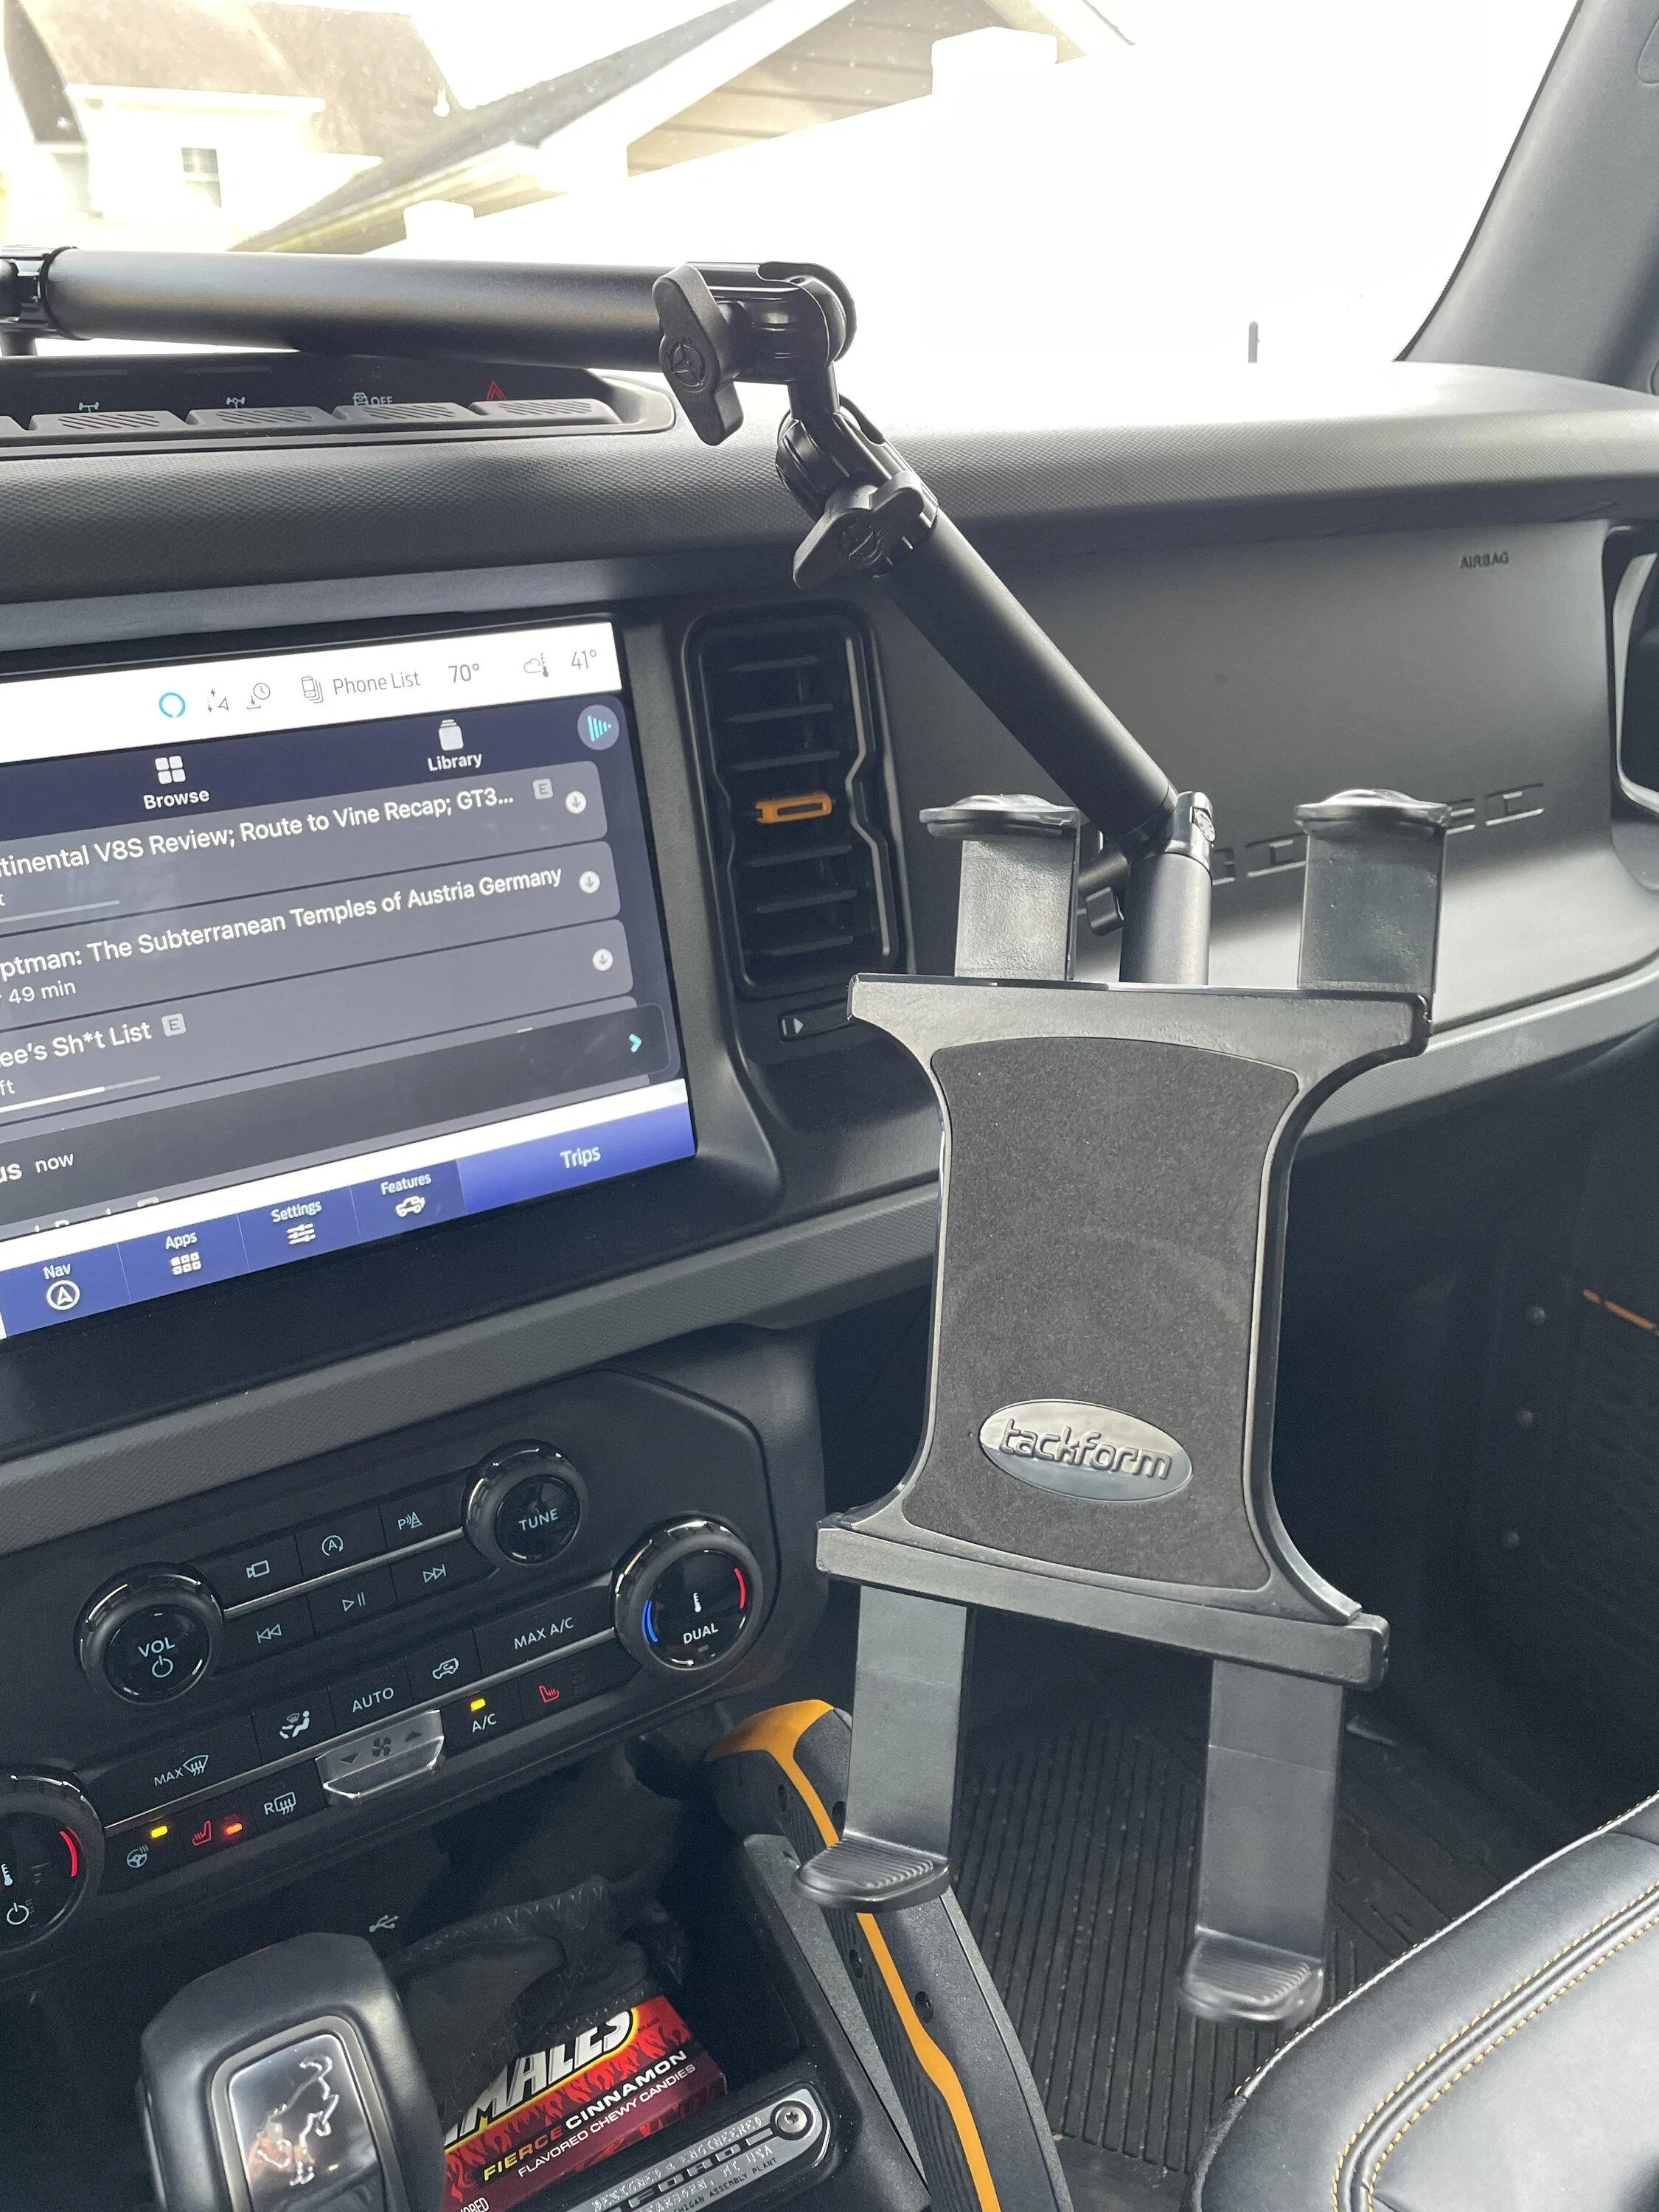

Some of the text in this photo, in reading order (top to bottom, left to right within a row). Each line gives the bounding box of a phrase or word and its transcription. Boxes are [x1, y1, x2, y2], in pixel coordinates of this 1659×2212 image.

[371, 395, 394, 406] OFF
[1460, 552, 1509, 569] AIRBAG
[571, 649, 597, 671] 41°
[333, 671, 421, 695] Phone List
[448, 663, 480, 684] 70°
[428, 752, 483, 772] Library
[143, 788, 210, 810] Browse
[0, 844, 90, 877] tinental
[94, 838, 144, 863] V8S
[149, 827, 236, 855] Review;
[240, 818, 303, 842] Route
[307, 810, 329, 832] to
[333, 804, 380, 829] Vine
[385, 795, 452, 818] Recap;
[86, 940, 133, 962] The
[138, 913, 286, 954] Subterranean
[289, 900, 377, 928] Temples
[381, 891, 402, 914] of
[408, 880, 475, 908] Austria
[479, 868, 563, 897] Germany
[8, 980, 77, 1005] 49 min
[0, 1042, 48, 1068] ee's
[109, 1021, 152, 1047] List
[35, 1153, 74, 1174] now
[560, 1145, 601, 1169] Trips
[381, 1172, 432, 1196] Features
[271, 1199, 322, 1223] Settings
[165, 1230, 198, 1249] Apps
[43, 1262, 72, 1280] Nav
[998, 1417, 1173, 1480] tackform
[518, 1508, 560, 1531] TUNE
[513, 1617, 574, 1650] MAX A/C
[682, 1623, 720, 1644] DUAL
[138, 1635, 176, 1658] VOL
[351, 1686, 395, 1713] AUTO
[471, 1712, 498, 1733] A/C
[153, 1767, 184, 1787] MAX
[444, 2010, 630, 2146] MALES
[483, 2050, 688, 2182] FIERCE CINNAMON
[518, 2064, 697, 2178] FLAVORED CHEWY CANDIES
[591, 2168, 661, 2212] DESIGNED
[679, 2116, 762, 2163] ENGINEERED
[746, 2144, 773, 2163] USA
[709, 2172, 748, 2197] ASSEMBLY
[752, 2157, 777, 2174] PLANT
